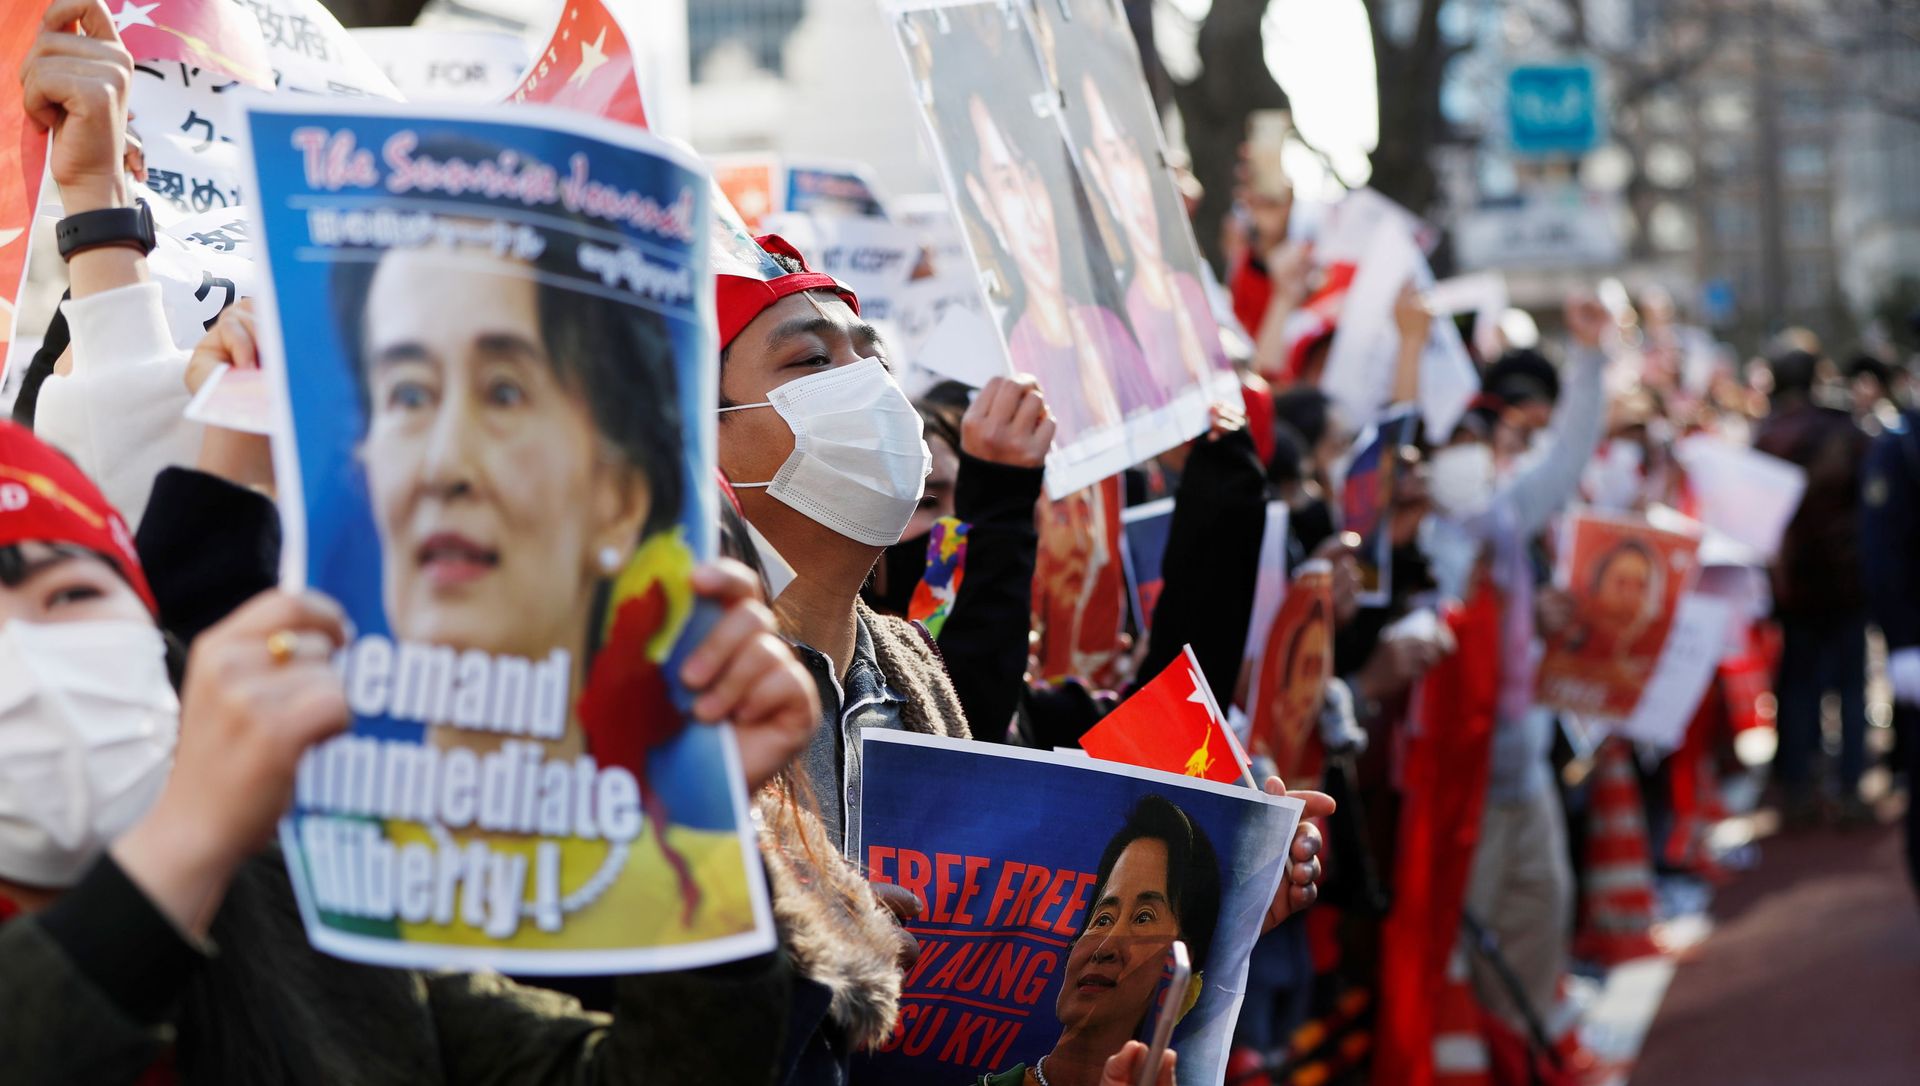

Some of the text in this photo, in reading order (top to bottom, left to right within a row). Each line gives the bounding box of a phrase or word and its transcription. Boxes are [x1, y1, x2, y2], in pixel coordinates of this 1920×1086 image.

[291, 127, 378, 190] The
[336, 634, 571, 740] emand
[868, 845, 1098, 937] FREE FREE
[926, 941, 1057, 1005] AUNG
[937, 1008, 1023, 1070] KYI
